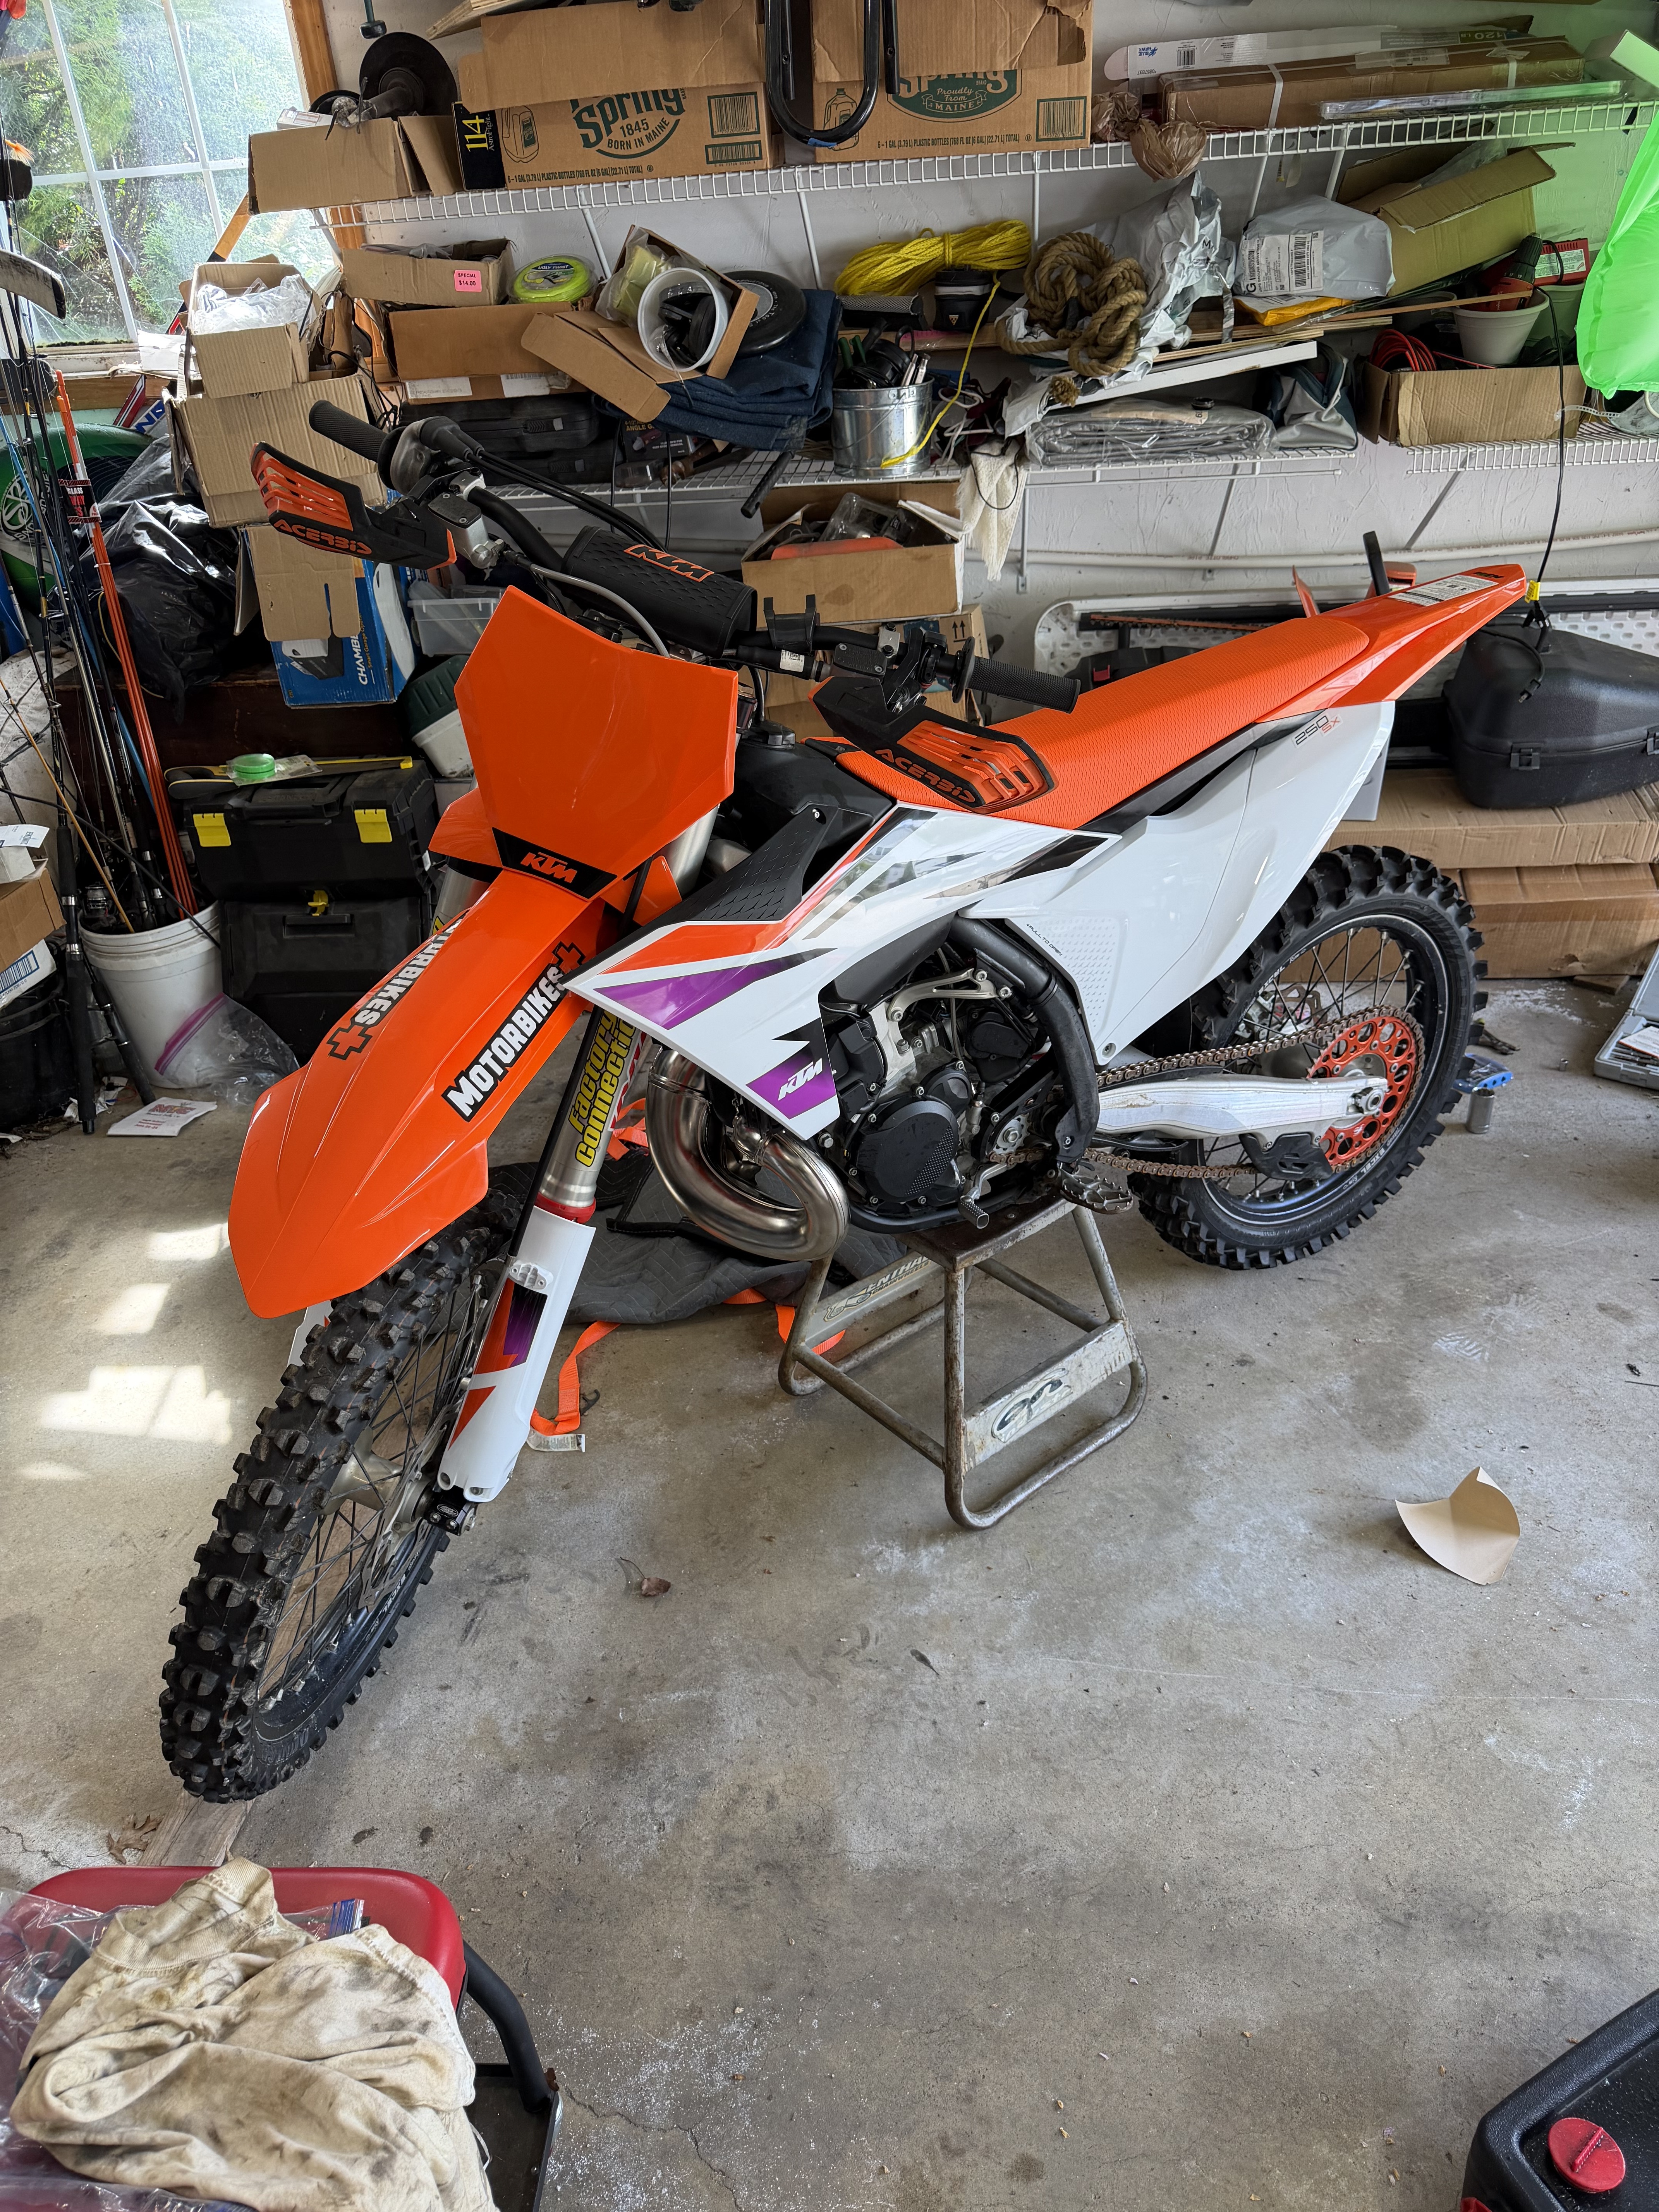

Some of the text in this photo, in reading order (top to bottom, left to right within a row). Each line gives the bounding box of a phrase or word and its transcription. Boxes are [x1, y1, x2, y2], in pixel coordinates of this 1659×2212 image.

[935, 101, 974, 111] MAINE
[936, 86, 974, 96] Proudly
[945, 94, 968, 102] From
[462, 115, 488, 152] 114
[607, 117, 670, 150] BORN IN MAINE
[620, 118, 649, 137] 1845
[889, 140, 897, 148] GAL
[914, 138, 930, 147] PLASTIC
[931, 137, 949, 146] BOTTLES
[965, 136, 971, 144] OZ
[541, 173, 558, 181] PLASTIC
[558, 172, 575, 180] BOTTLES
[1245, 281, 1257, 294] G
[274, 519, 372, 555] ACERBIS
[624, 544, 714, 582] KTM
[1294, 715, 1341, 746] 250 SX
[874, 749, 976, 803] ACERBIS
[520, 852, 577, 884] KTM
[1029, 925, 1042, 938] PULL
[1049, 943, 1063, 957] OPEN
[445, 965, 569, 1118] MOTORBIKES
[568, 1008, 619, 1132] Factory
[778, 1058, 823, 1101] KTM
[1360, 1147, 1385, 1173] EXCEL
